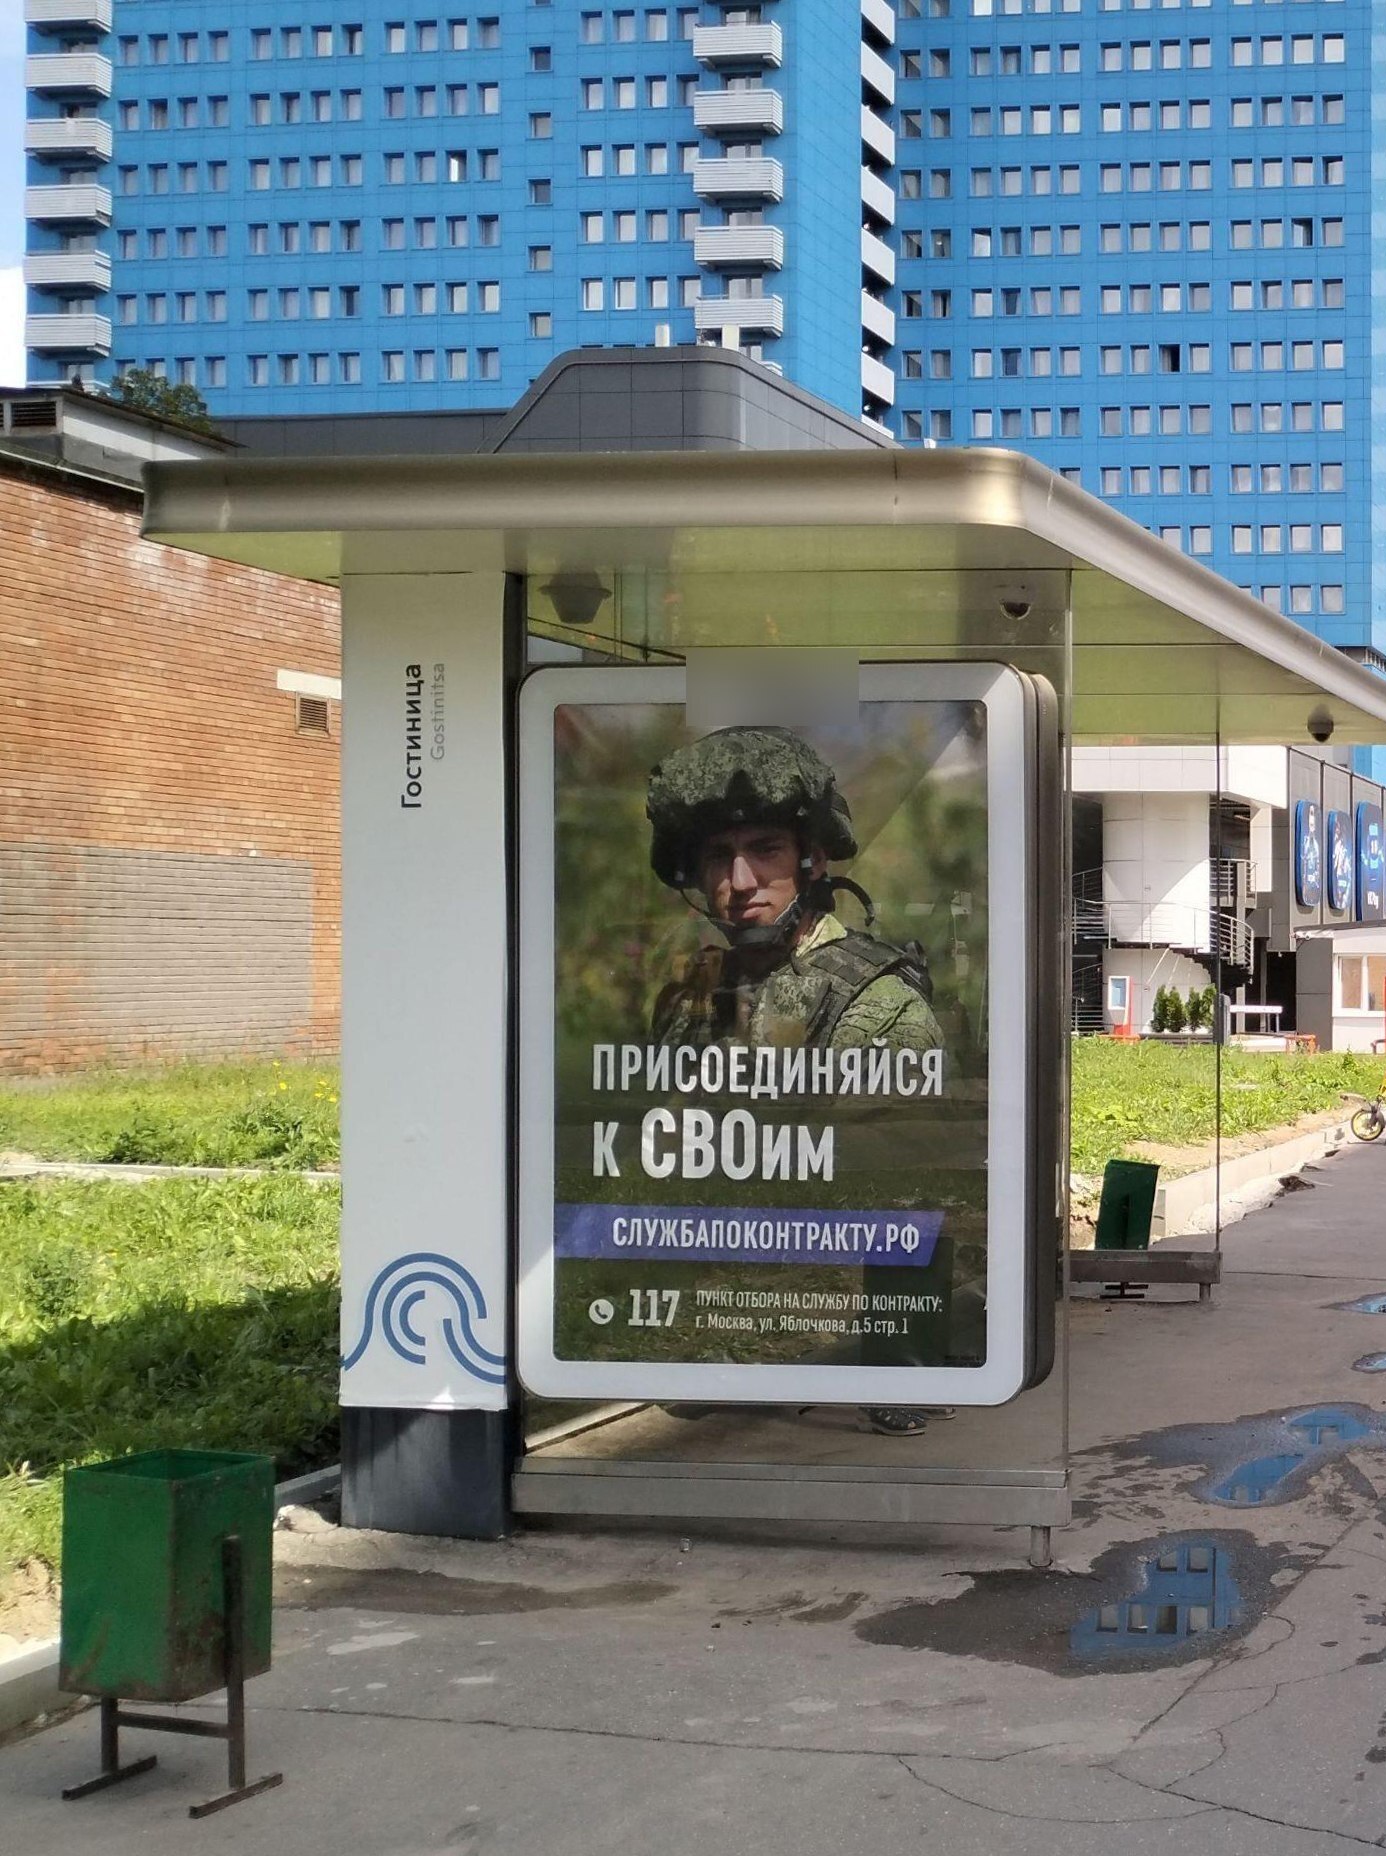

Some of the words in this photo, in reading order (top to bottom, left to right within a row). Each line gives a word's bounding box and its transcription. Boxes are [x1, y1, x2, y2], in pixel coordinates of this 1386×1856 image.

[430, 663, 445, 760] Gostinitsa
[401, 664, 424, 808] Гостиница
[592, 1037, 943, 1100] ПРИСОЕДИНЯЙСЯ
[612, 1216, 920, 1254] СЛУЖБАПОКОНТРАКТУ.РФ
[628, 1289, 680, 1327] 117
[696, 1290, 735, 1308] ПУНКТ
[736, 1291, 781, 1309] ОТБОРА
[783, 1292, 801, 1310] НА
[802, 1293, 850, 1311] СЛУЖБУ
[853, 1294, 869, 1311] ПО
[872, 1295, 943, 1313] КОНТРАКТУ:
[696, 1316, 704, 1329] г.
[707, 1313, 757, 1333] Москва,
[759, 1318, 777, 1334] ул.
[779, 1315, 850, 1336] Яблочкова,
[874, 1321, 899, 1338] стр.
[902, 1318, 909, 1334] 1
